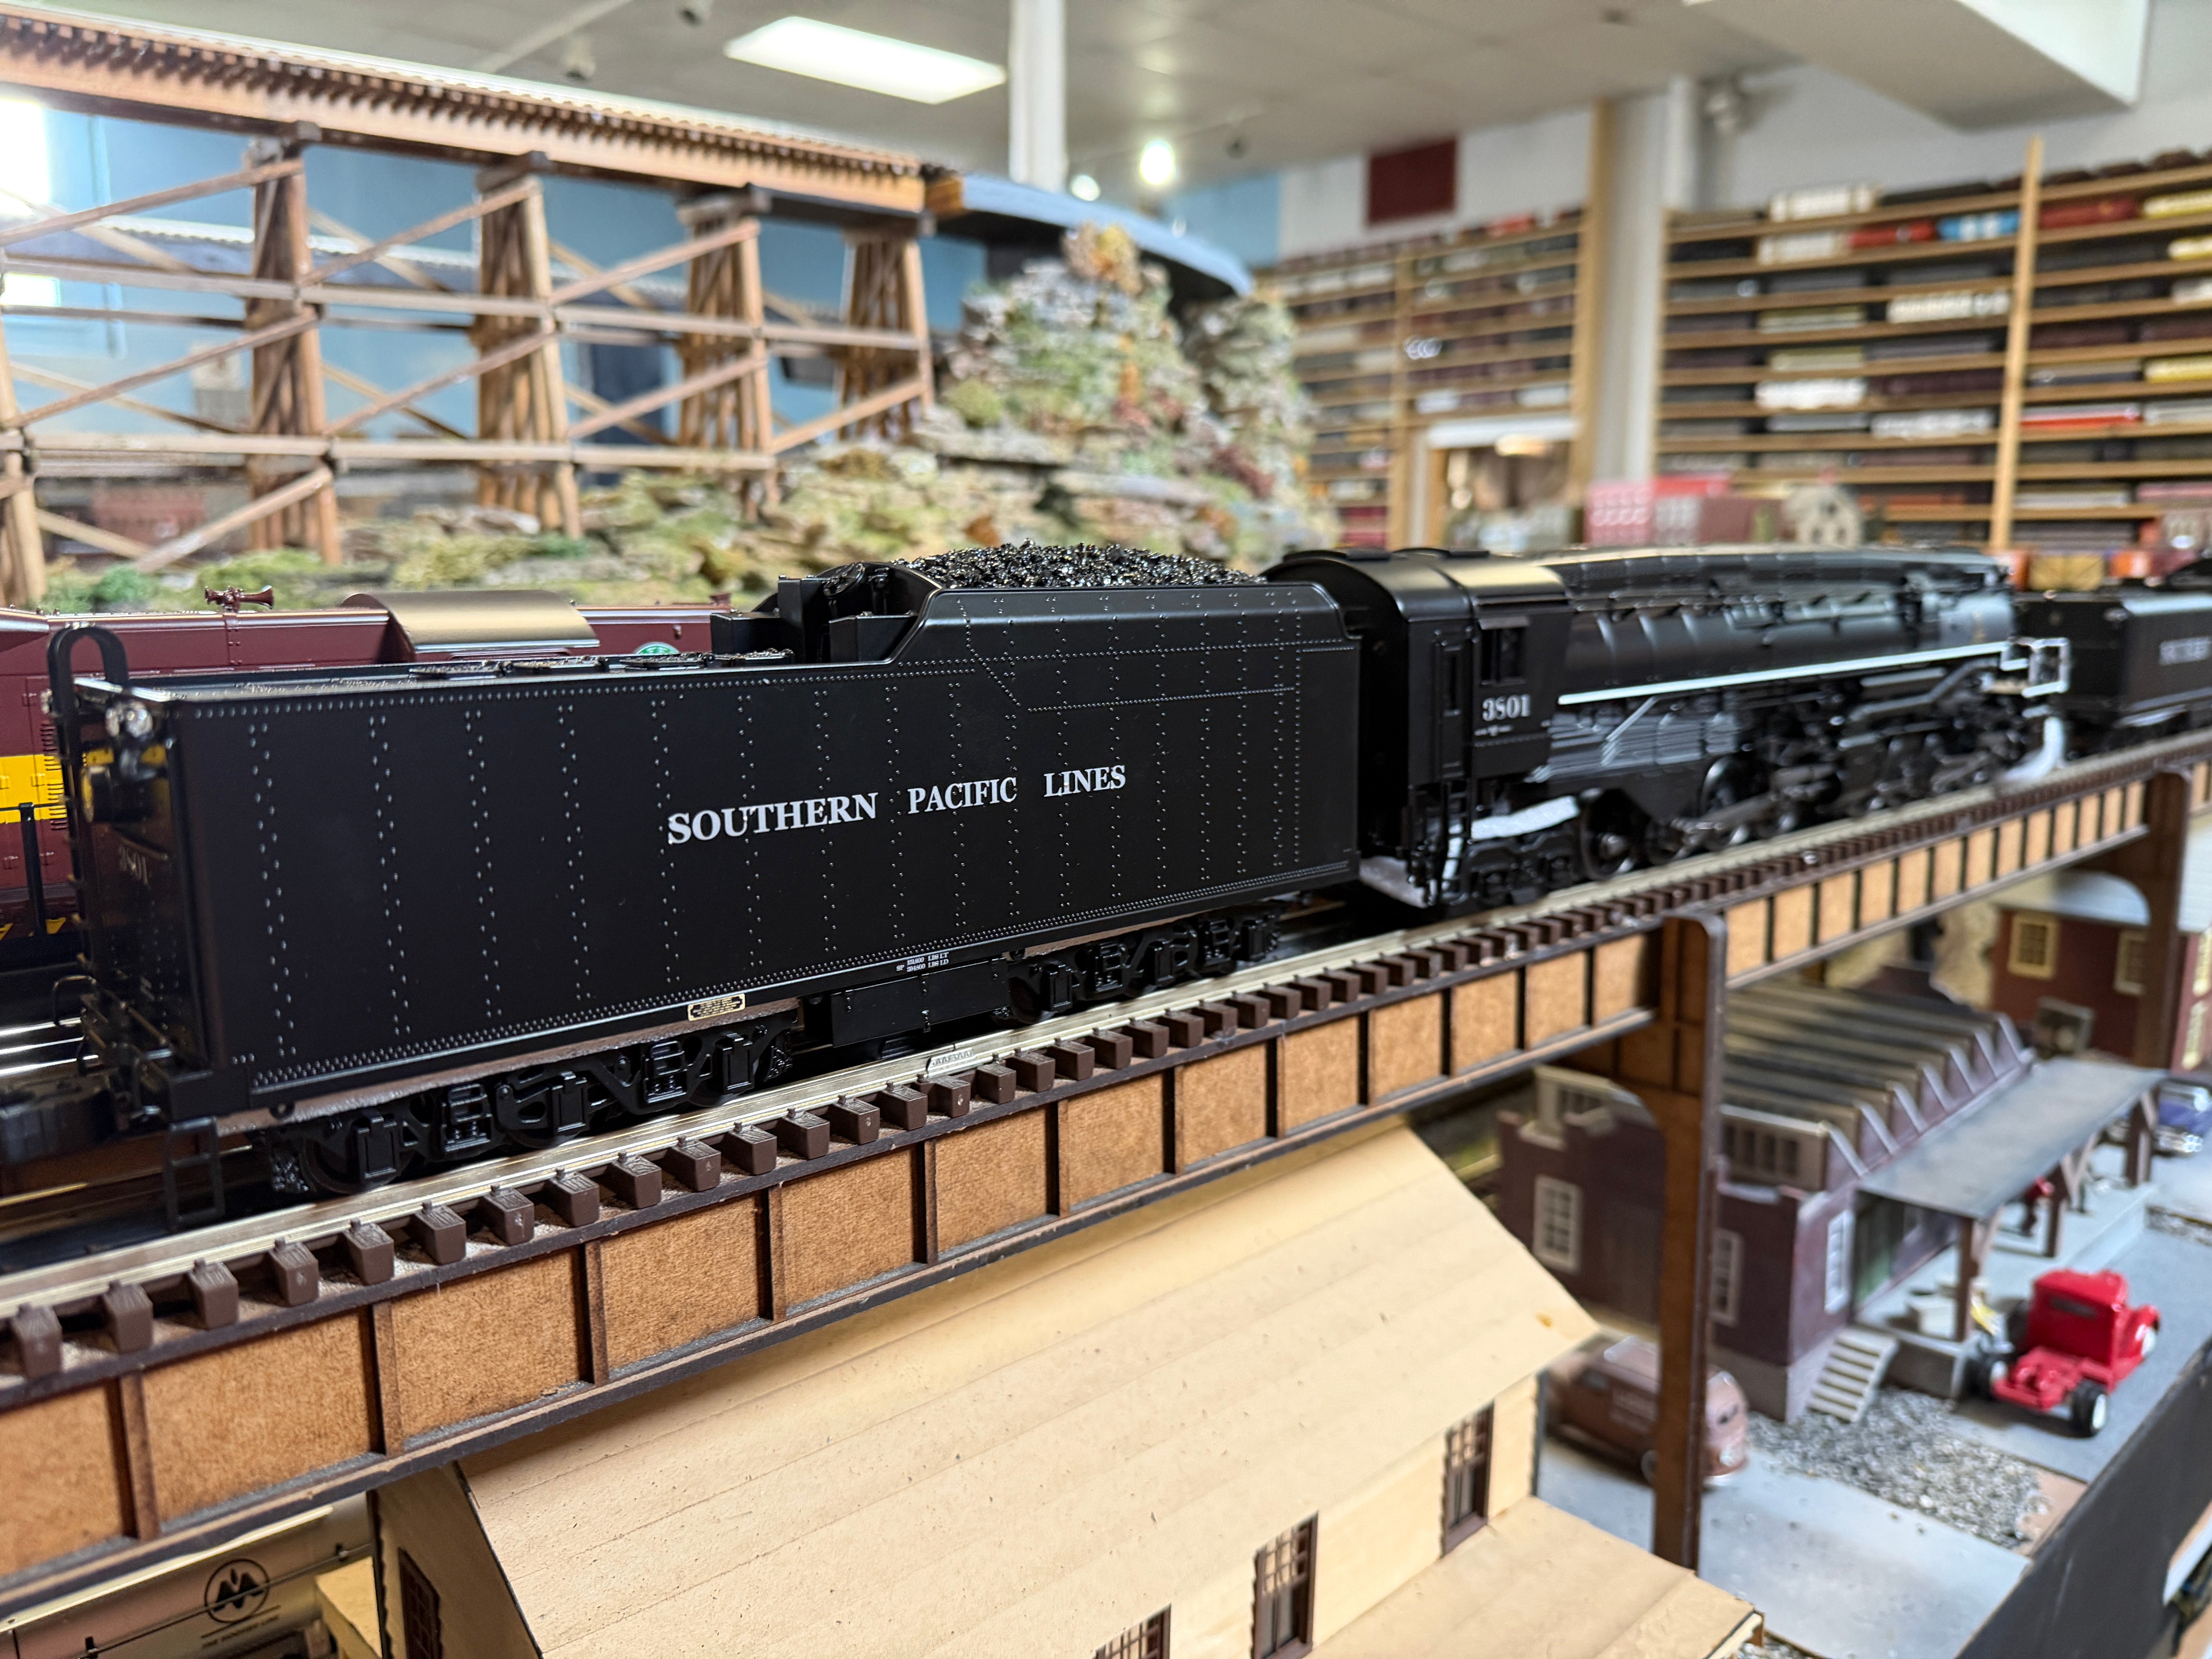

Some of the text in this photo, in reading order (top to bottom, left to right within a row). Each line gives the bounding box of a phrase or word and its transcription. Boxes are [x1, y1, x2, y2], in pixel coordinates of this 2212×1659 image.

[668, 764, 1126, 845] SOUTHERN PACIFIC LINES
